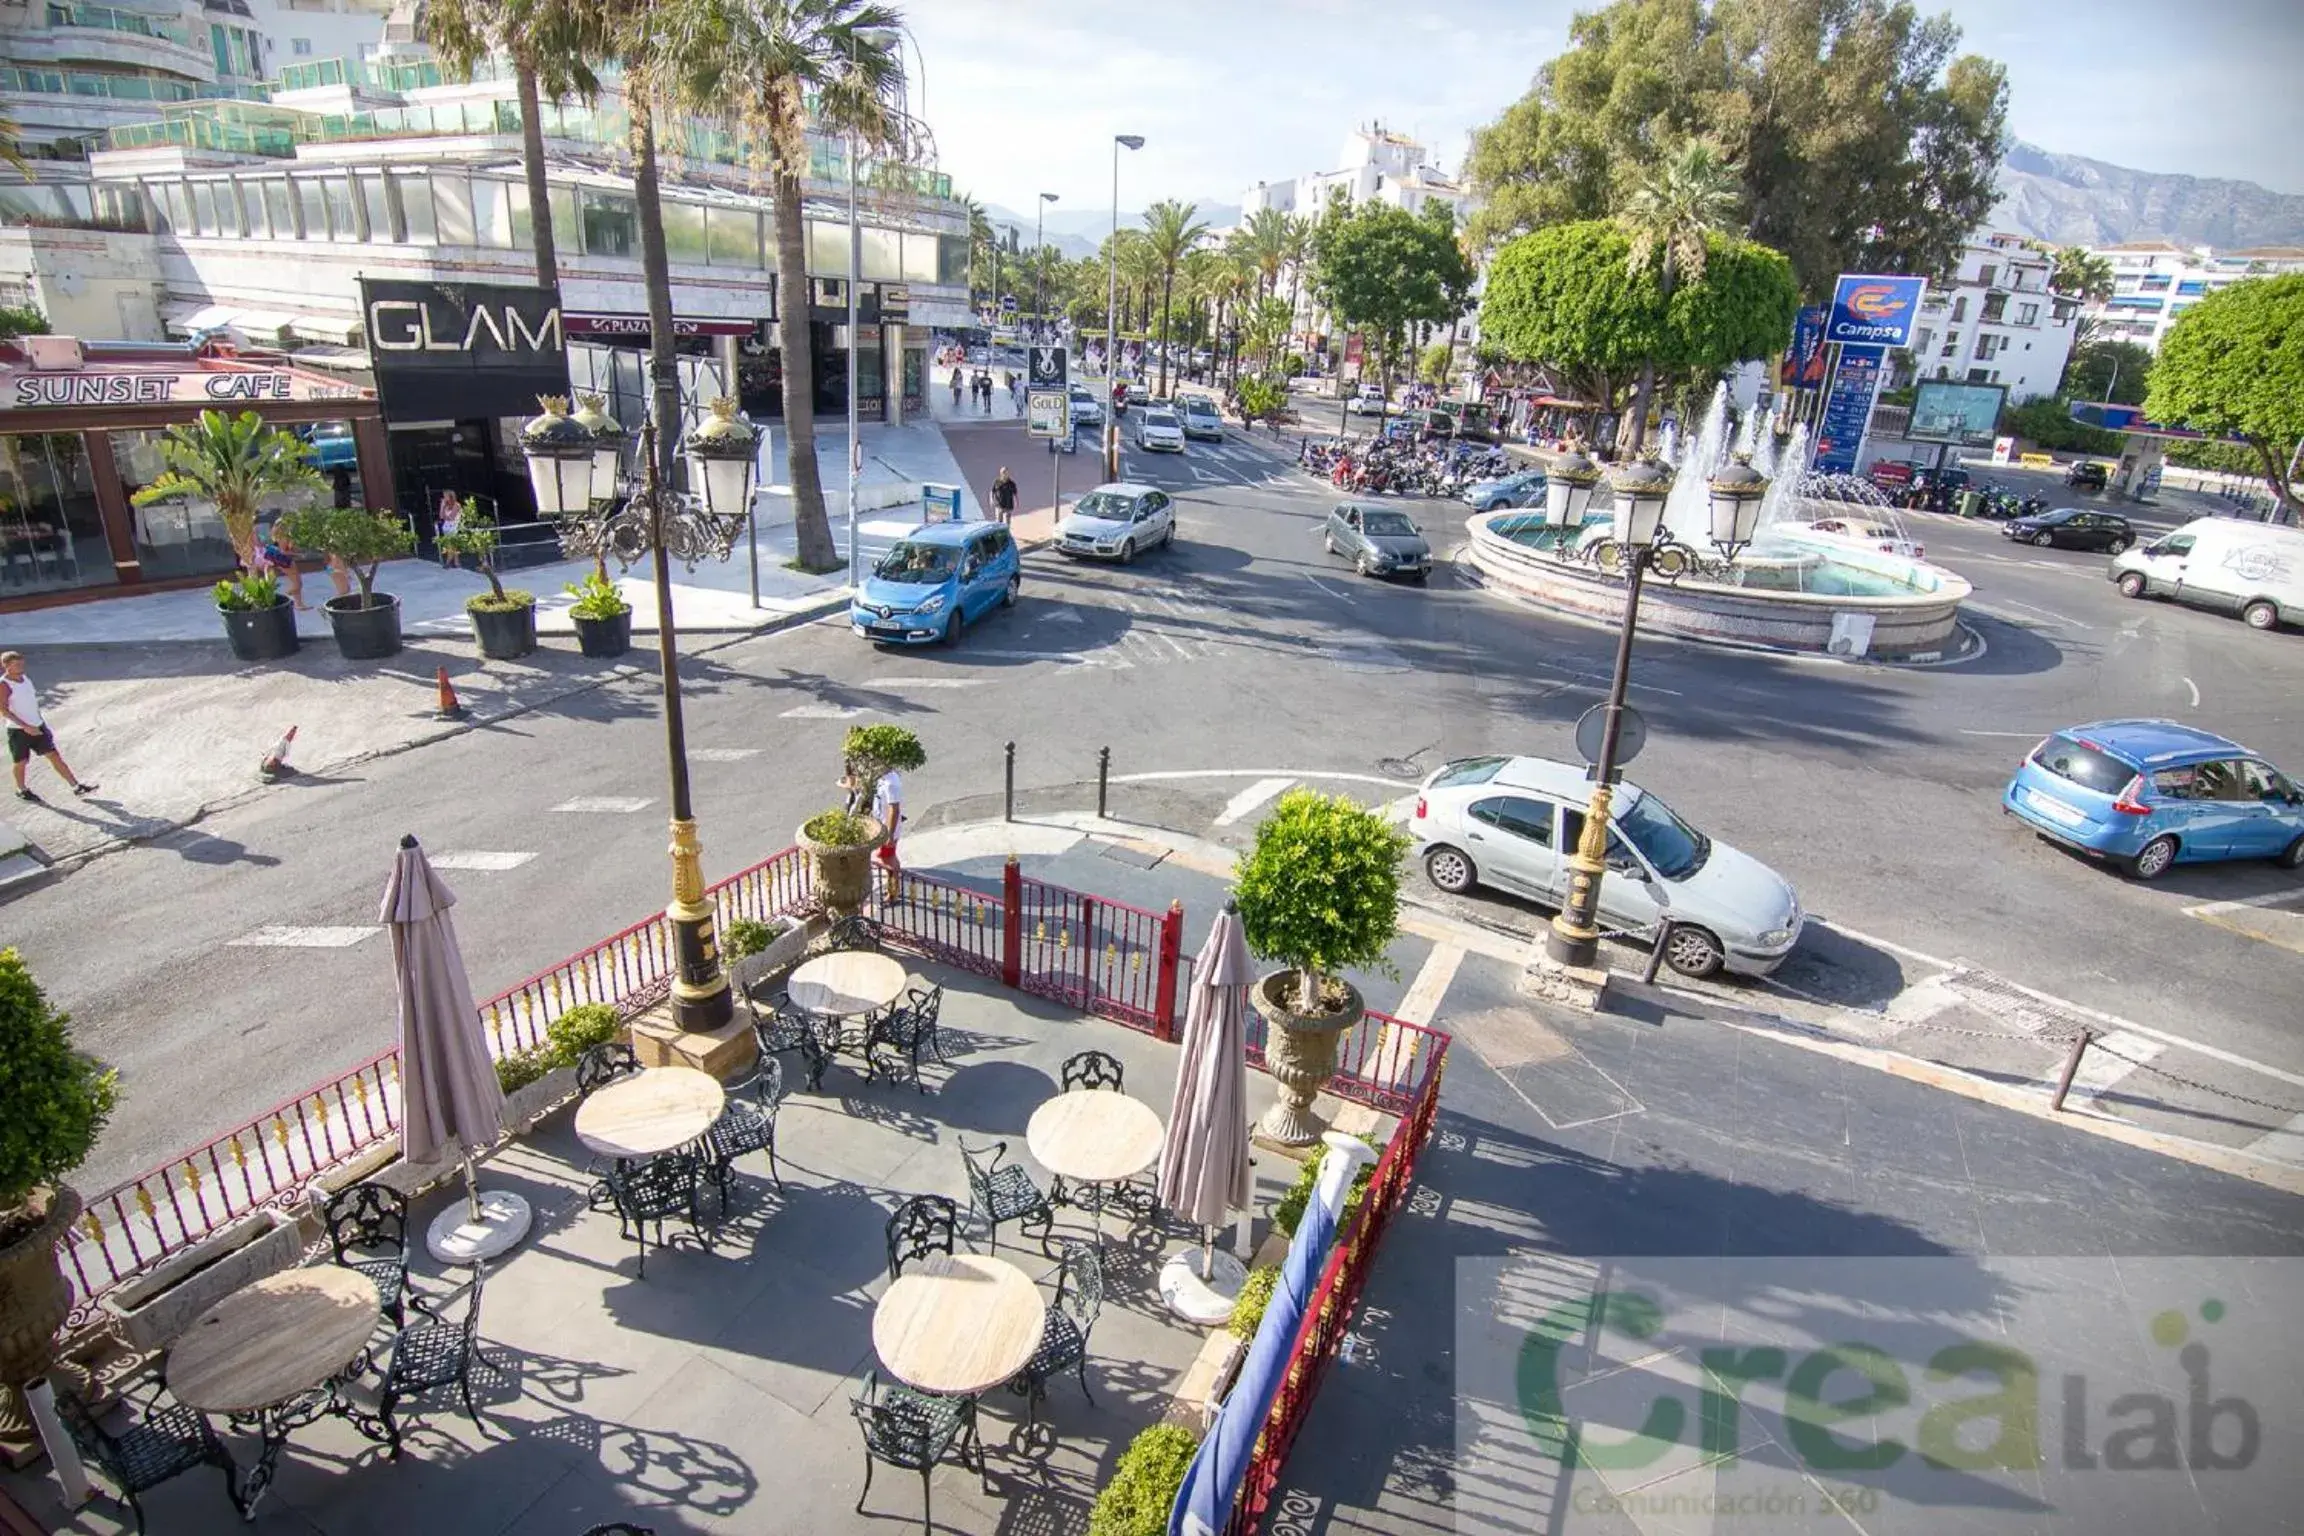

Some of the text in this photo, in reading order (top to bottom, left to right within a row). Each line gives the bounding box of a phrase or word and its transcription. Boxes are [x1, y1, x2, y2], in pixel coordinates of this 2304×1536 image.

[371, 300, 563, 350] GLAM
[612, 320, 649, 333] PLAZA
[1836, 322, 1902, 340] Campsa
[15, 376, 179, 404] SUNSET
[205, 375, 292, 400] CAFE
